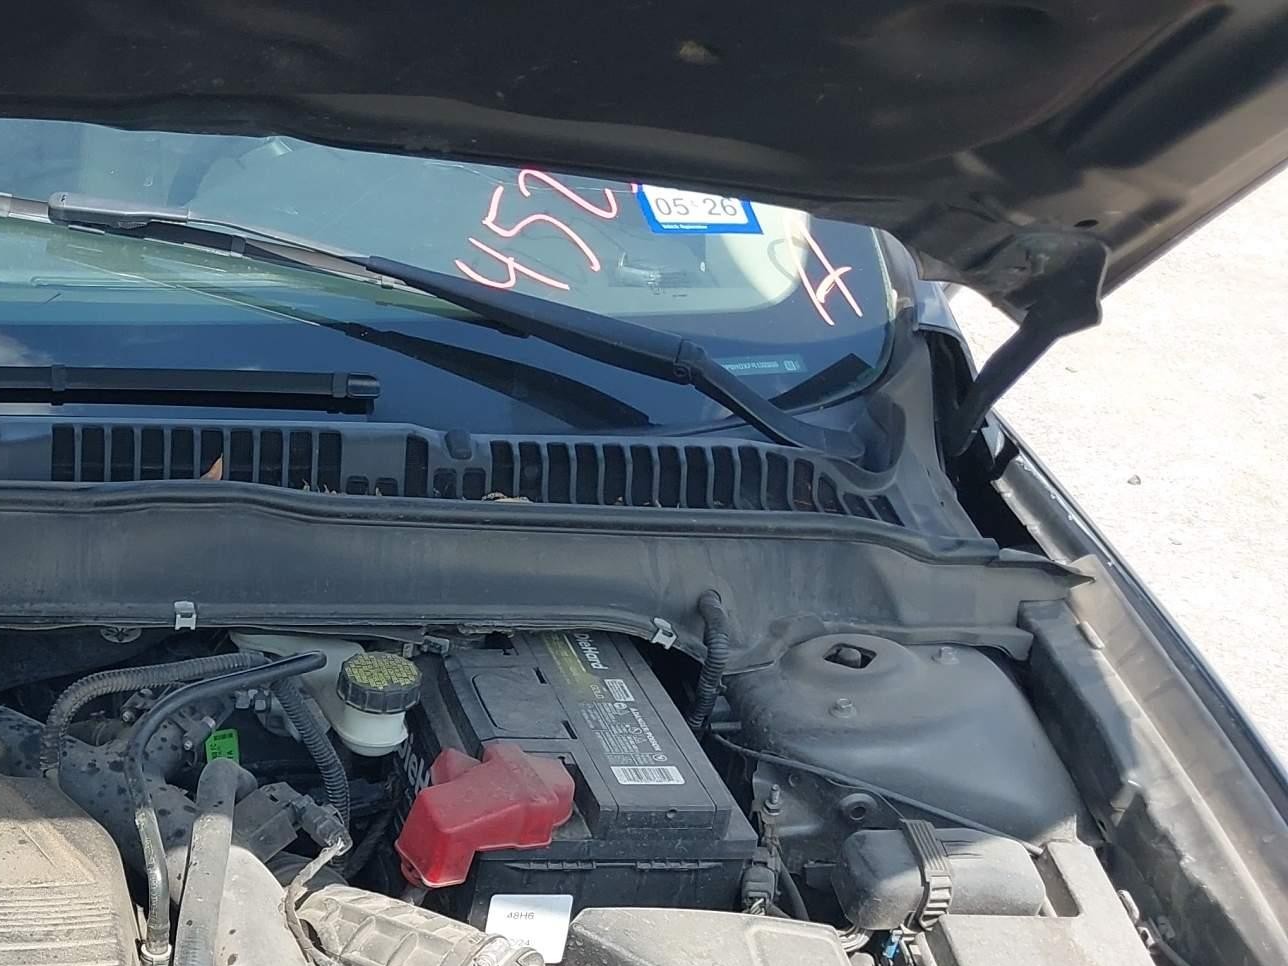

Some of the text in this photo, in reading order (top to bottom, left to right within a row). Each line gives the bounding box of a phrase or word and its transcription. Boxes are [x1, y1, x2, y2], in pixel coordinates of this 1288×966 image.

[655, 197, 737, 216] 05 26
[454, 168, 638, 290] 452
[573, 633, 609, 670] DieHard
